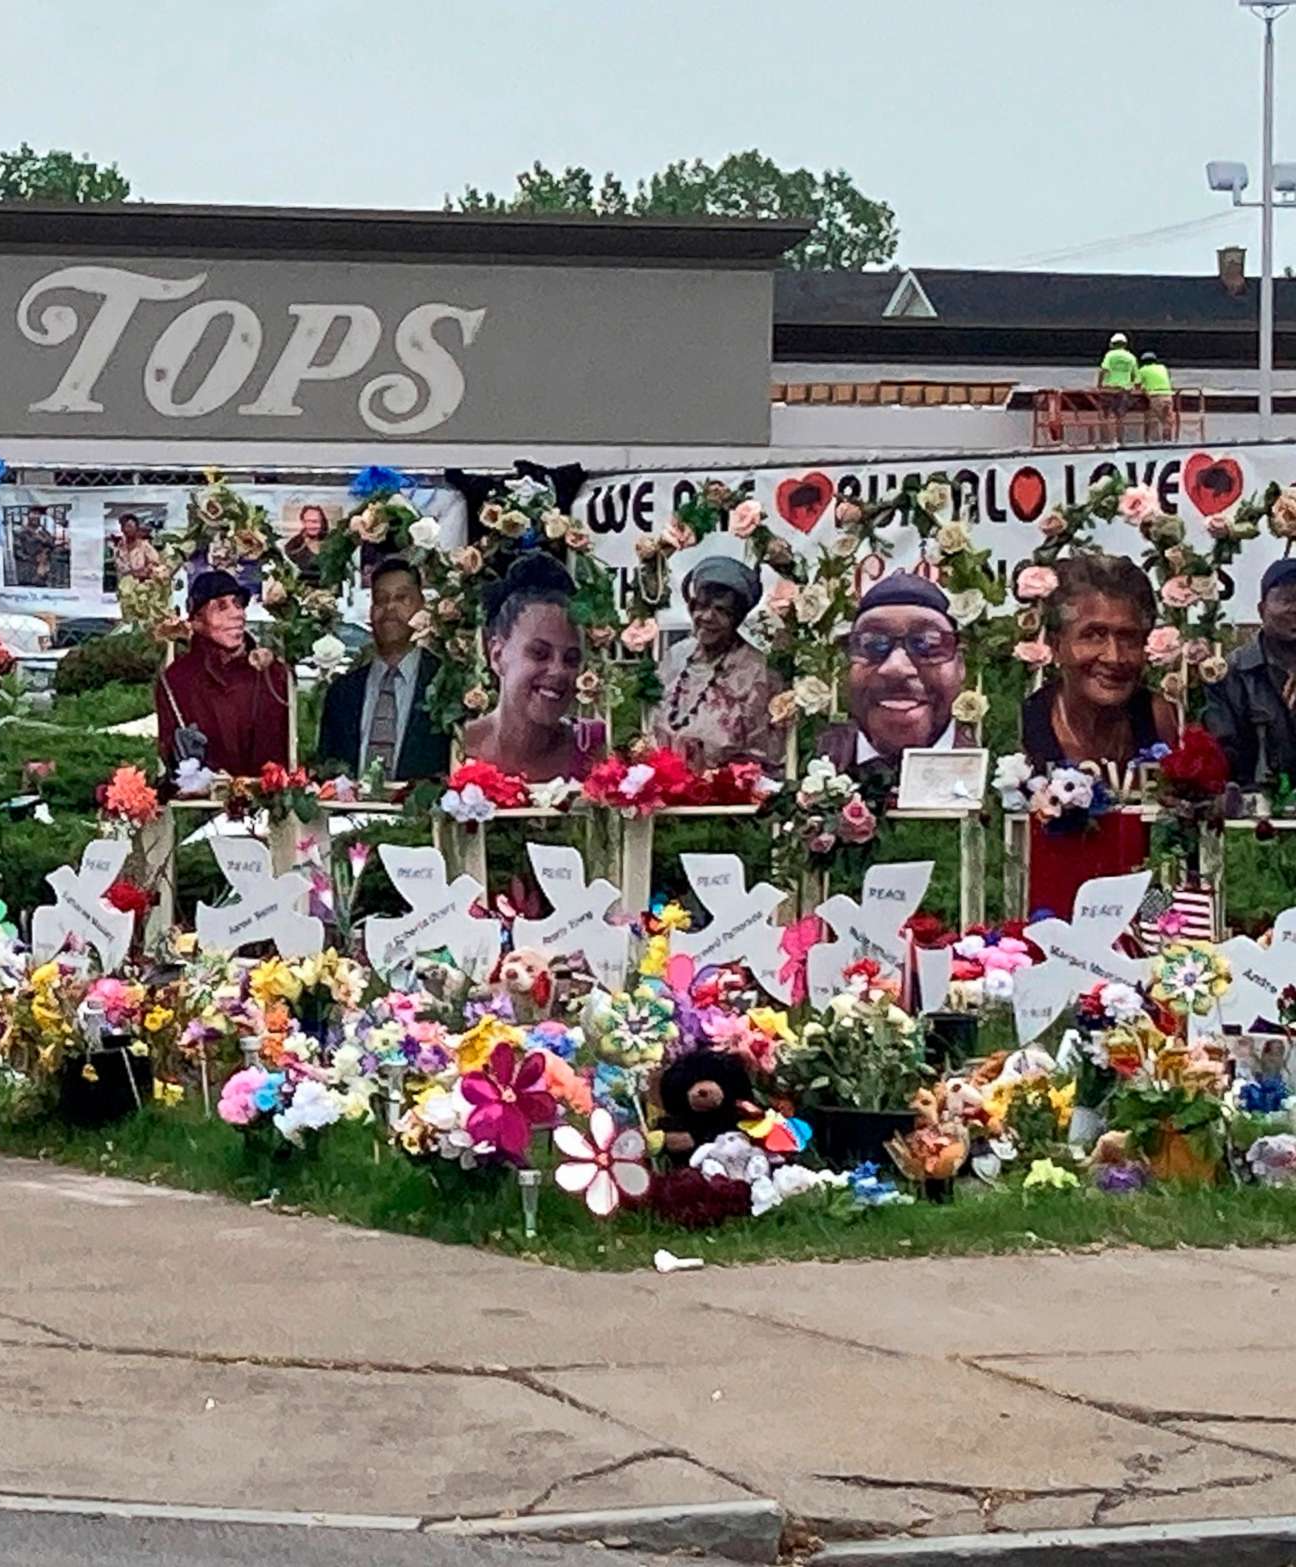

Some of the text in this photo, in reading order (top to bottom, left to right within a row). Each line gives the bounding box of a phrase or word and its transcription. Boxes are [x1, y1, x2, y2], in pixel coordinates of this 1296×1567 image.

[587, 480, 654, 533] WE
[869, 888, 906, 901] PEACE
[1081, 905, 1124, 919] PEACE
